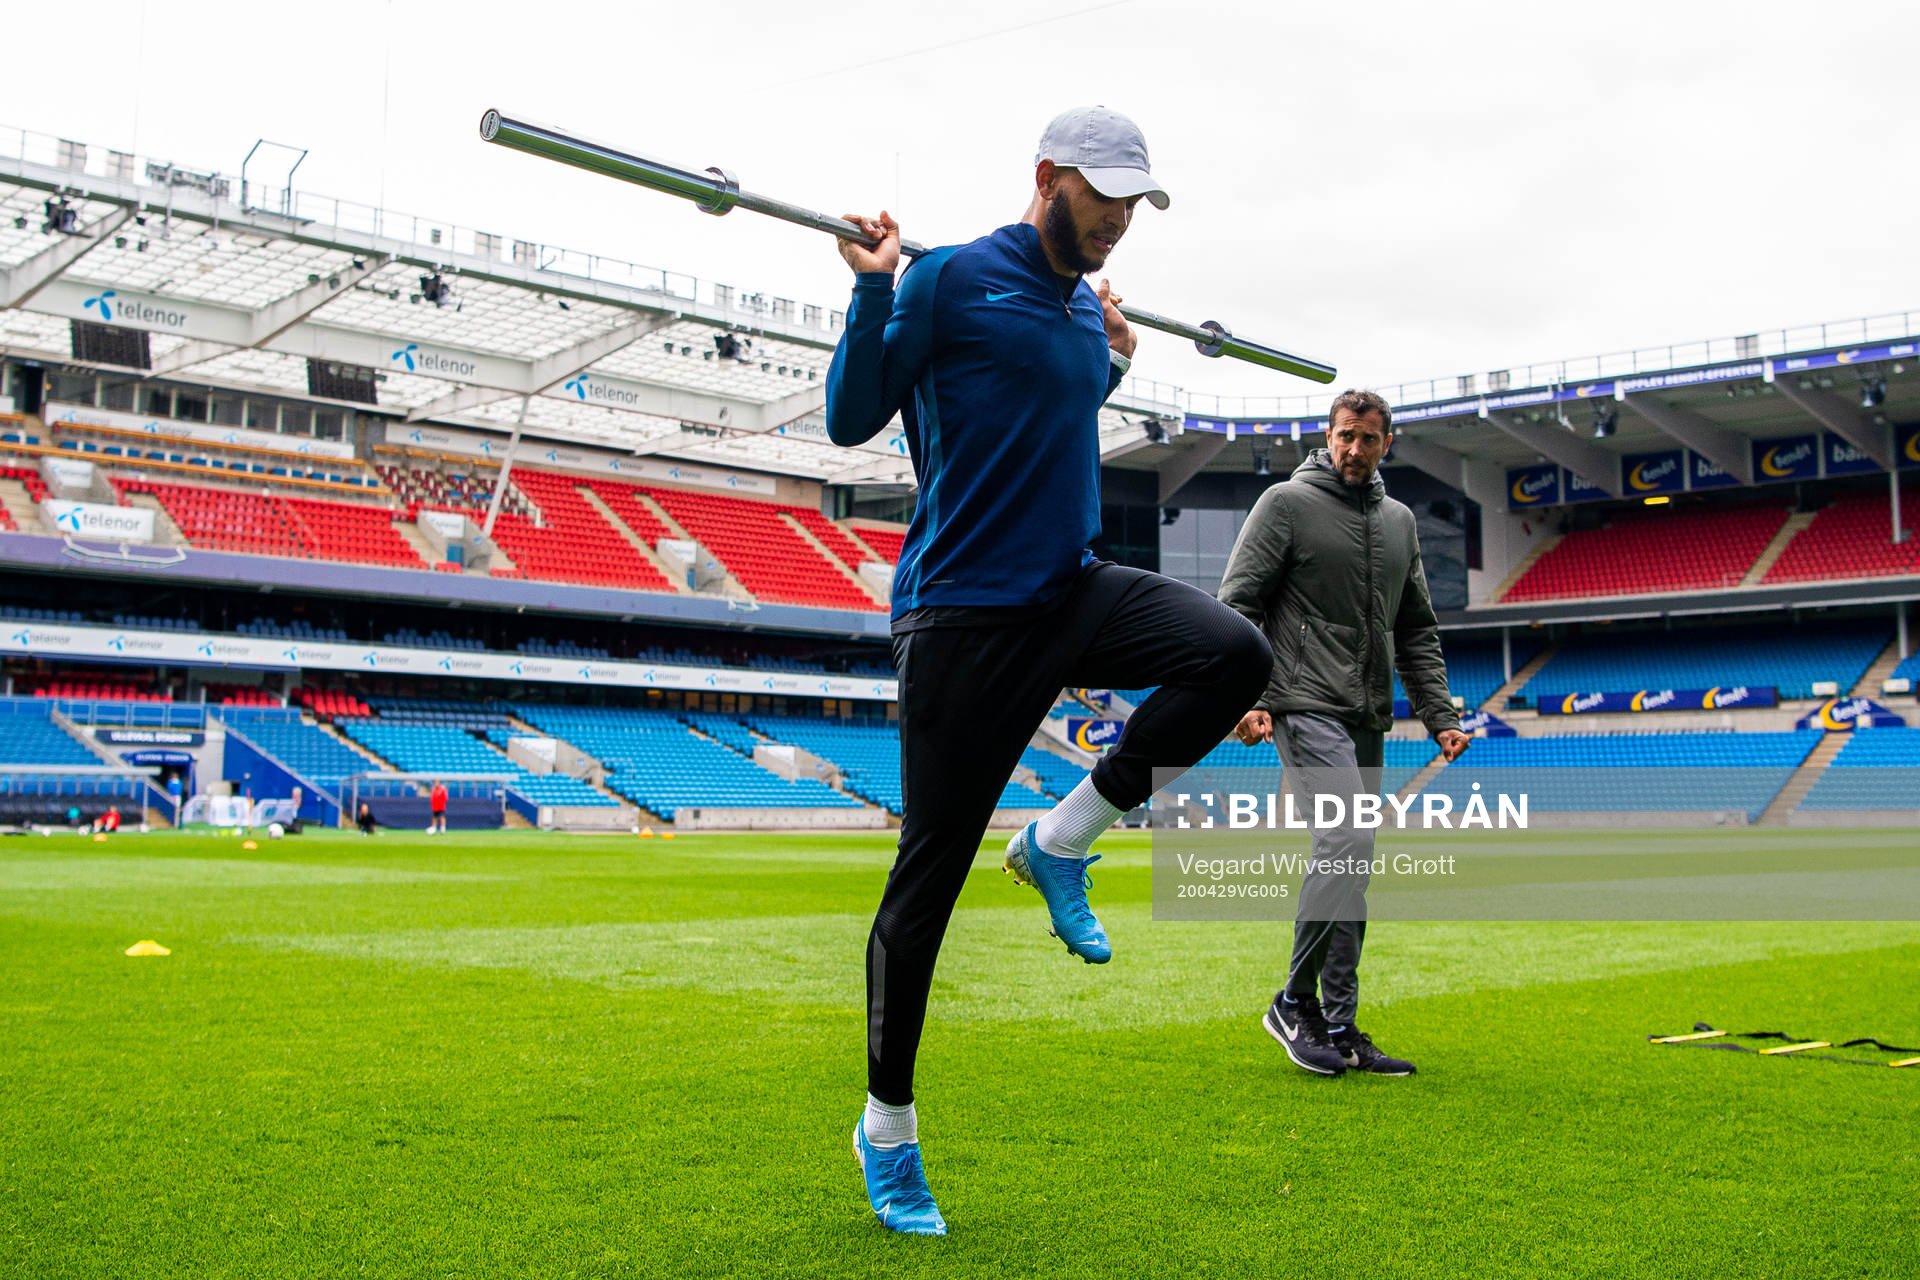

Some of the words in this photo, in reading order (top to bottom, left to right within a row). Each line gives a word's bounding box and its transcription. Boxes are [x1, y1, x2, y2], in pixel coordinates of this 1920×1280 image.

[117, 301, 187, 328] telenor
[419, 354, 476, 377] telenor
[588, 383, 640, 405] telenor
[788, 418, 827, 437] teleno
[83, 513, 141, 531] telenor
